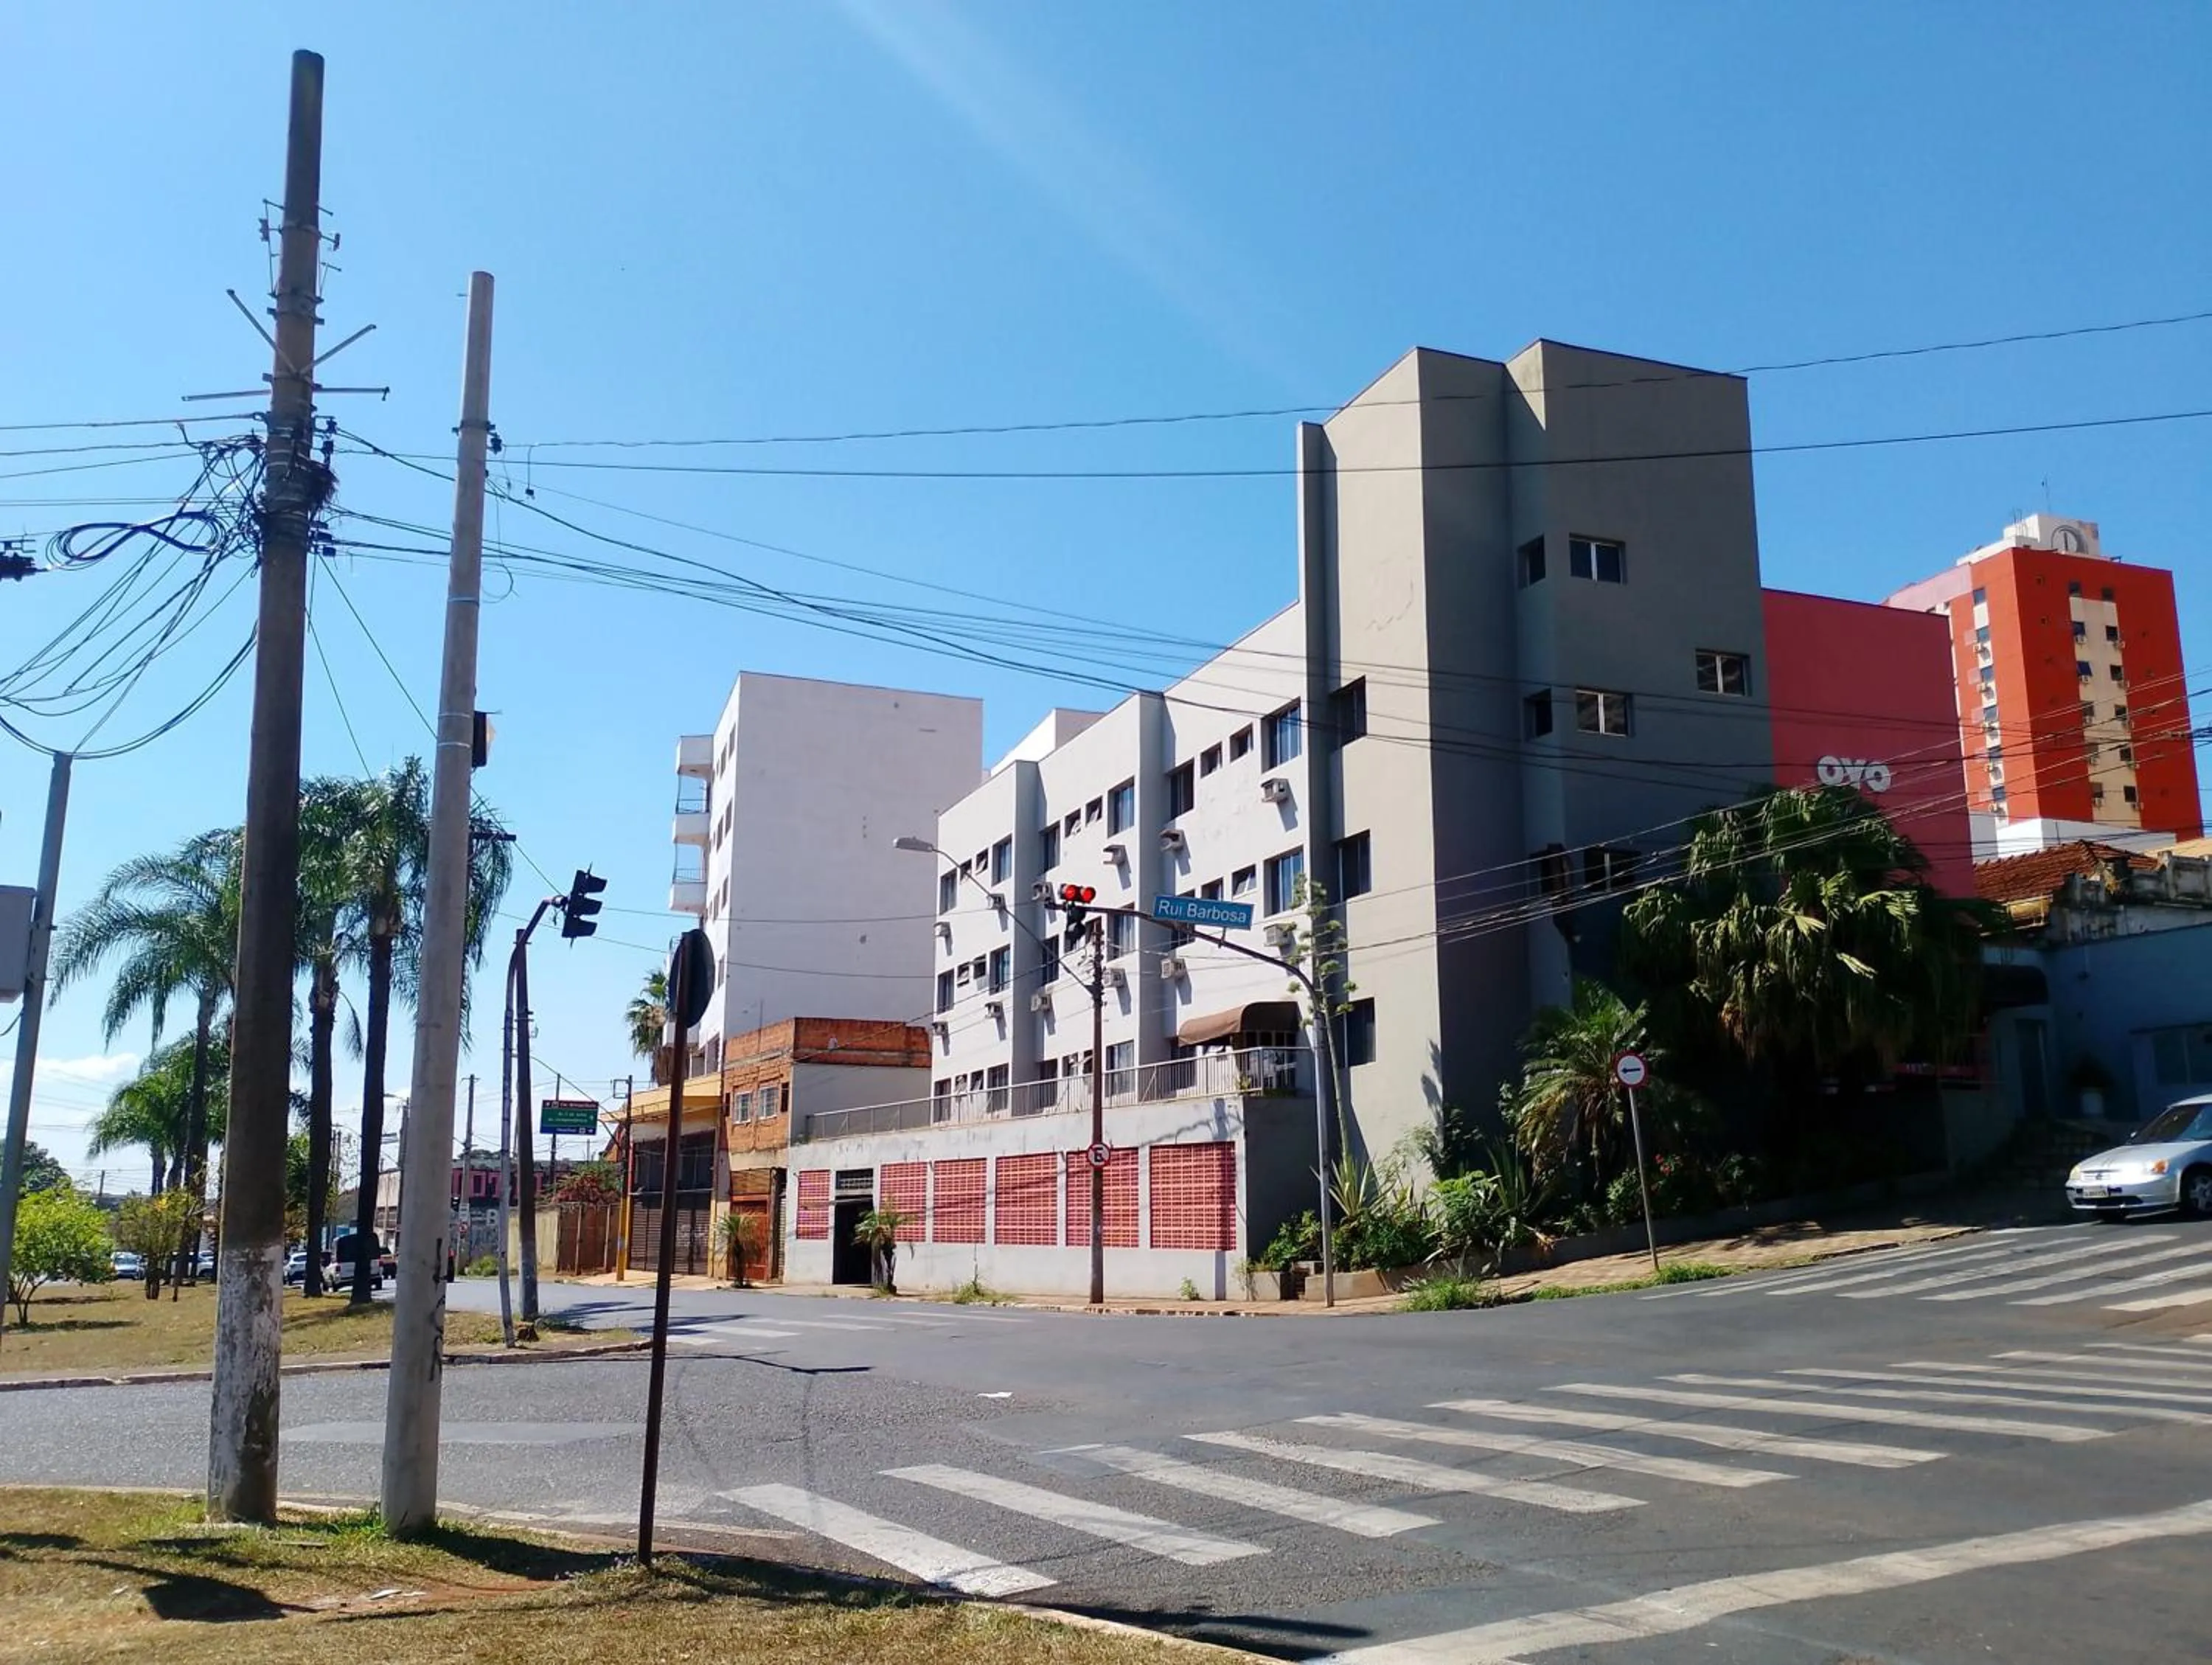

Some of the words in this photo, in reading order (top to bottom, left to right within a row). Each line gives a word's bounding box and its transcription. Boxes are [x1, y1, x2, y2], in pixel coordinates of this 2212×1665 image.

[1818, 756, 1891, 791] OYO
[1158, 900, 1182, 915] Rui
[1186, 903, 1247, 923] Barbosa
